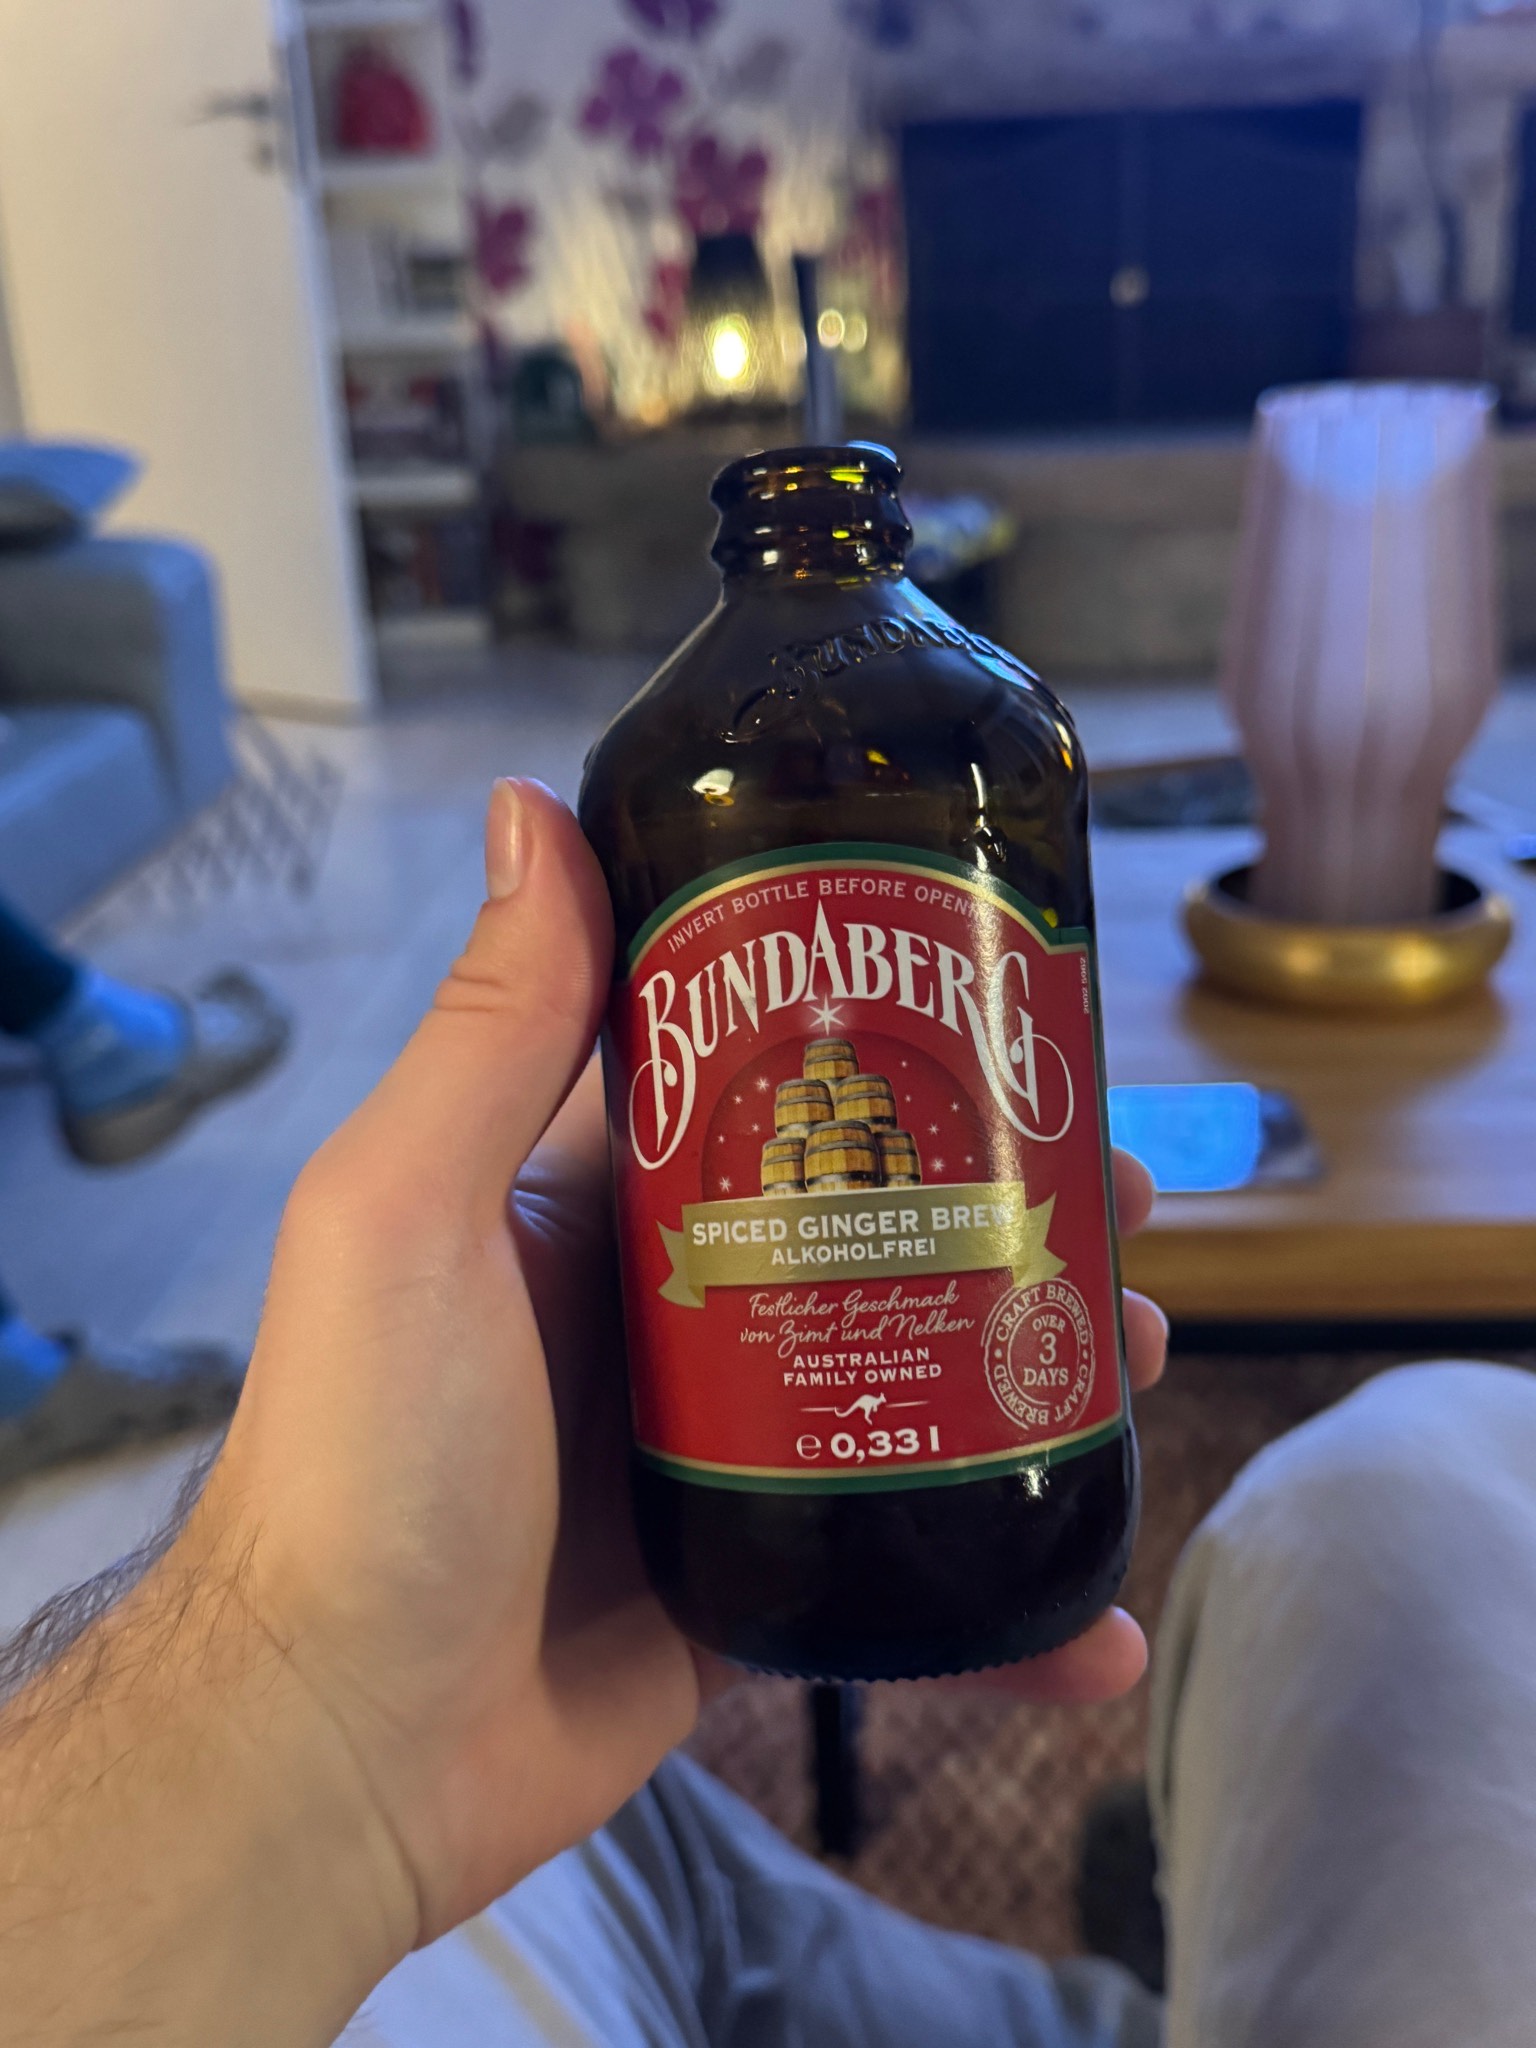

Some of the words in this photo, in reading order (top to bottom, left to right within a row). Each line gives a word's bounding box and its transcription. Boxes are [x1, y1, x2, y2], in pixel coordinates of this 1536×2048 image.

[666, 904, 725, 954] INVERT
[732, 881, 809, 915] BOTTLE
[819, 878, 906, 898] BEFORE
[629, 899, 1074, 1170] BUNDABERG
[692, 1218, 788, 1247] SPICED
[798, 1210, 919, 1241] GINGER
[771, 1237, 936, 1266] ALKOHOLFREI
[749, 1291, 838, 1319] Festlicher
[841, 1279, 960, 1328] Geschmack
[996, 1287, 1041, 1342] CRAFT
[1046, 1284, 1089, 1345] BREWED
[740, 1327, 775, 1344] von
[778, 1319, 838, 1359] Zimt
[840, 1314, 889, 1342] und
[888, 1308, 975, 1341] Nelken
[1032, 1314, 1066, 1334] OVER
[793, 1347, 931, 1369] AUSTRALIAN
[1039, 1332, 1057, 1365] 3
[783, 1370, 858, 1387] FAMILY
[864, 1364, 942, 1384] OWNED
[1023, 1367, 1069, 1386] DAYS
[1054, 1364, 1089, 1423] CRAFT
[993, 1364, 1049, 1426] BREWED
[830, 1427, 920, 1464] 0,33
